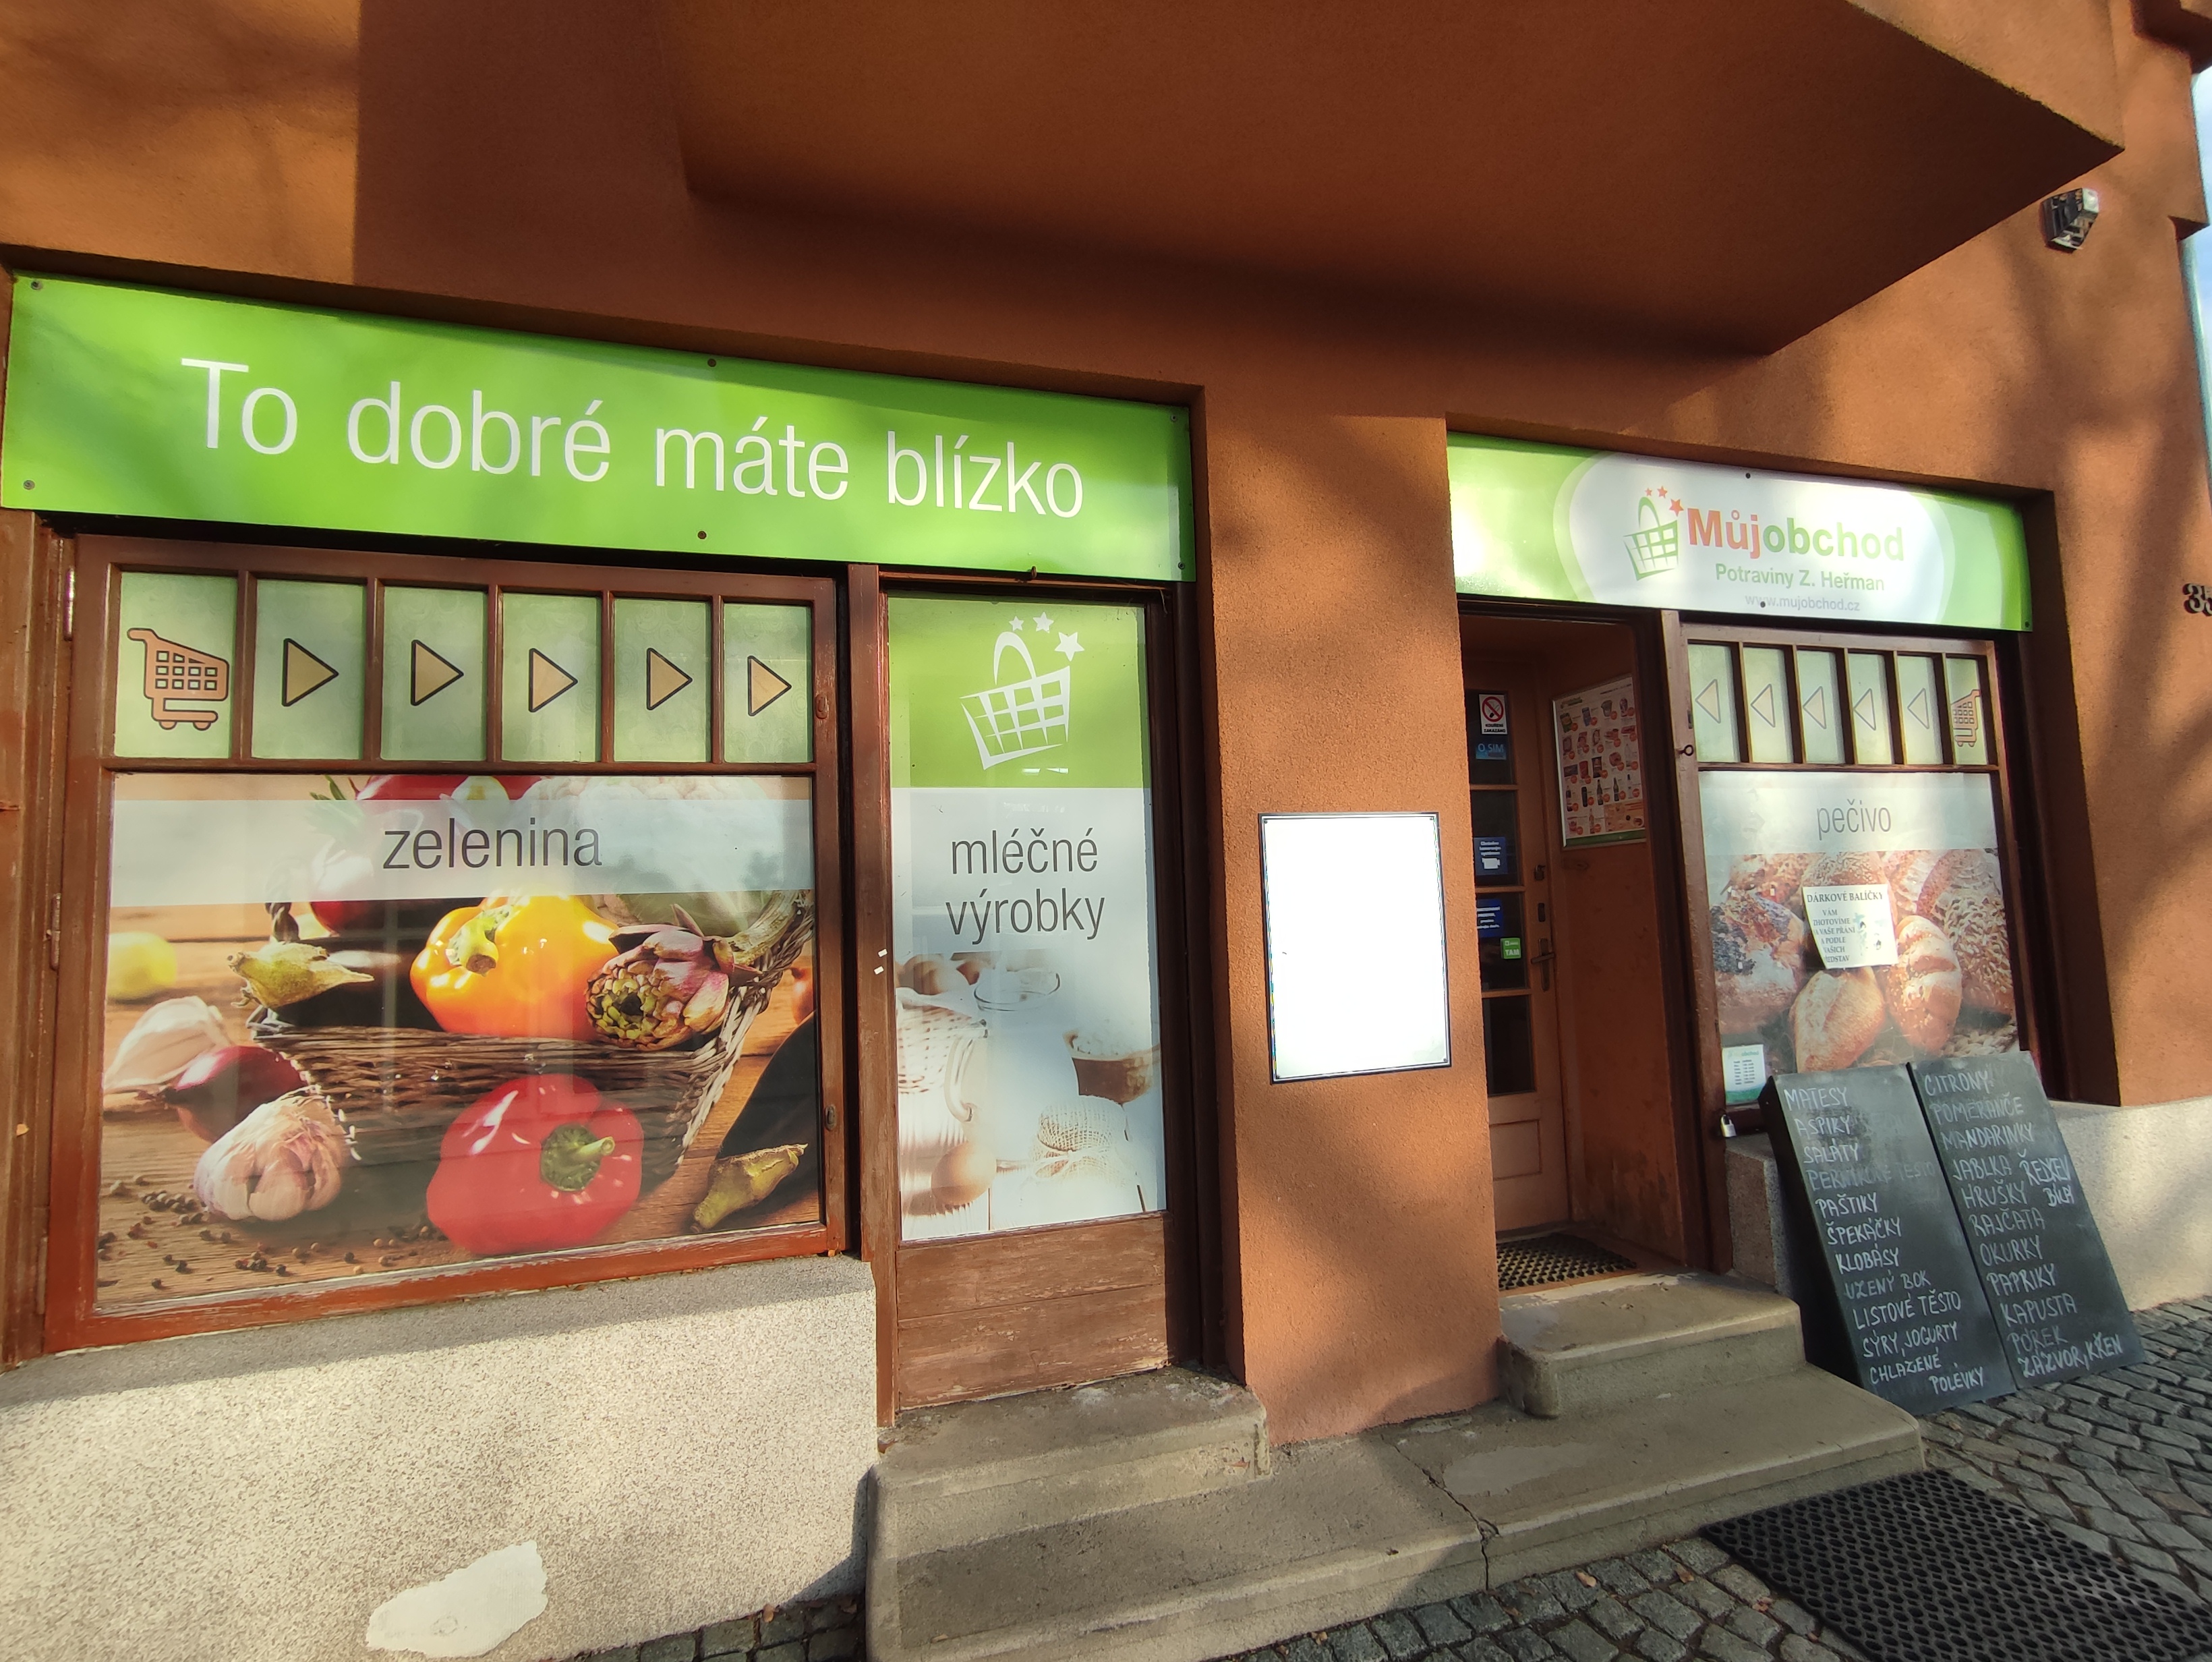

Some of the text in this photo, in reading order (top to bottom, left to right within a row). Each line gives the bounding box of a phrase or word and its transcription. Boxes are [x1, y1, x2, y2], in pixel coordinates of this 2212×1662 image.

[181, 357, 1083, 518] To dobré máte blízko
[1716, 563, 1884, 591] Potraviny Z. Heřman
[1745, 594, 1860, 611] www.mujobchod.cz
[1488, 743, 1504, 753] SIM
[1817, 798, 1892, 840] pečivo
[383, 818, 602, 869] zelenina
[952, 828, 1098, 874] mléčné
[1807, 890, 1883, 902] DÁRKOVÉ BALÍČKY
[946, 888, 1105, 945] výrobky
[1822, 908, 1838, 916] VÁM
[1925, 1070, 1989, 1096] CITRONY
[1784, 1087, 1849, 1112] MATESY
[1929, 1091, 2024, 1125] POMERANČE
[1794, 1115, 1851, 1139] ASPIKY
[1940, 1122, 2035, 1151] MANDARINKY
[1803, 1138, 1859, 1164] SALÁTY
[1952, 1155, 2012, 1181] JABLKA
[1815, 1192, 1878, 1218] PAŠTIKY
[1960, 1179, 2027, 1209] HRUŠKY
[1826, 1217, 1902, 1245] ŠPEKÁČKY
[1969, 1207, 2045, 1237] RAJČATA
[1835, 1243, 1899, 1275] KLOBÁSY
[1980, 1234, 2043, 1266] OKURKY
[1844, 1269, 1931, 1299] UZENÝ BOK
[1987, 1263, 2056, 1296] PAPRIKY
[1853, 1288, 1961, 1330] LISTOVÉ TĚSTO
[2000, 1293, 2078, 1327] KAPUSTA
[2007, 1326, 2068, 1354] PÓREK
[1869, 1346, 1942, 1384] CHLAZENÉ
[1929, 1363, 1984, 1394] POLÉVKY
